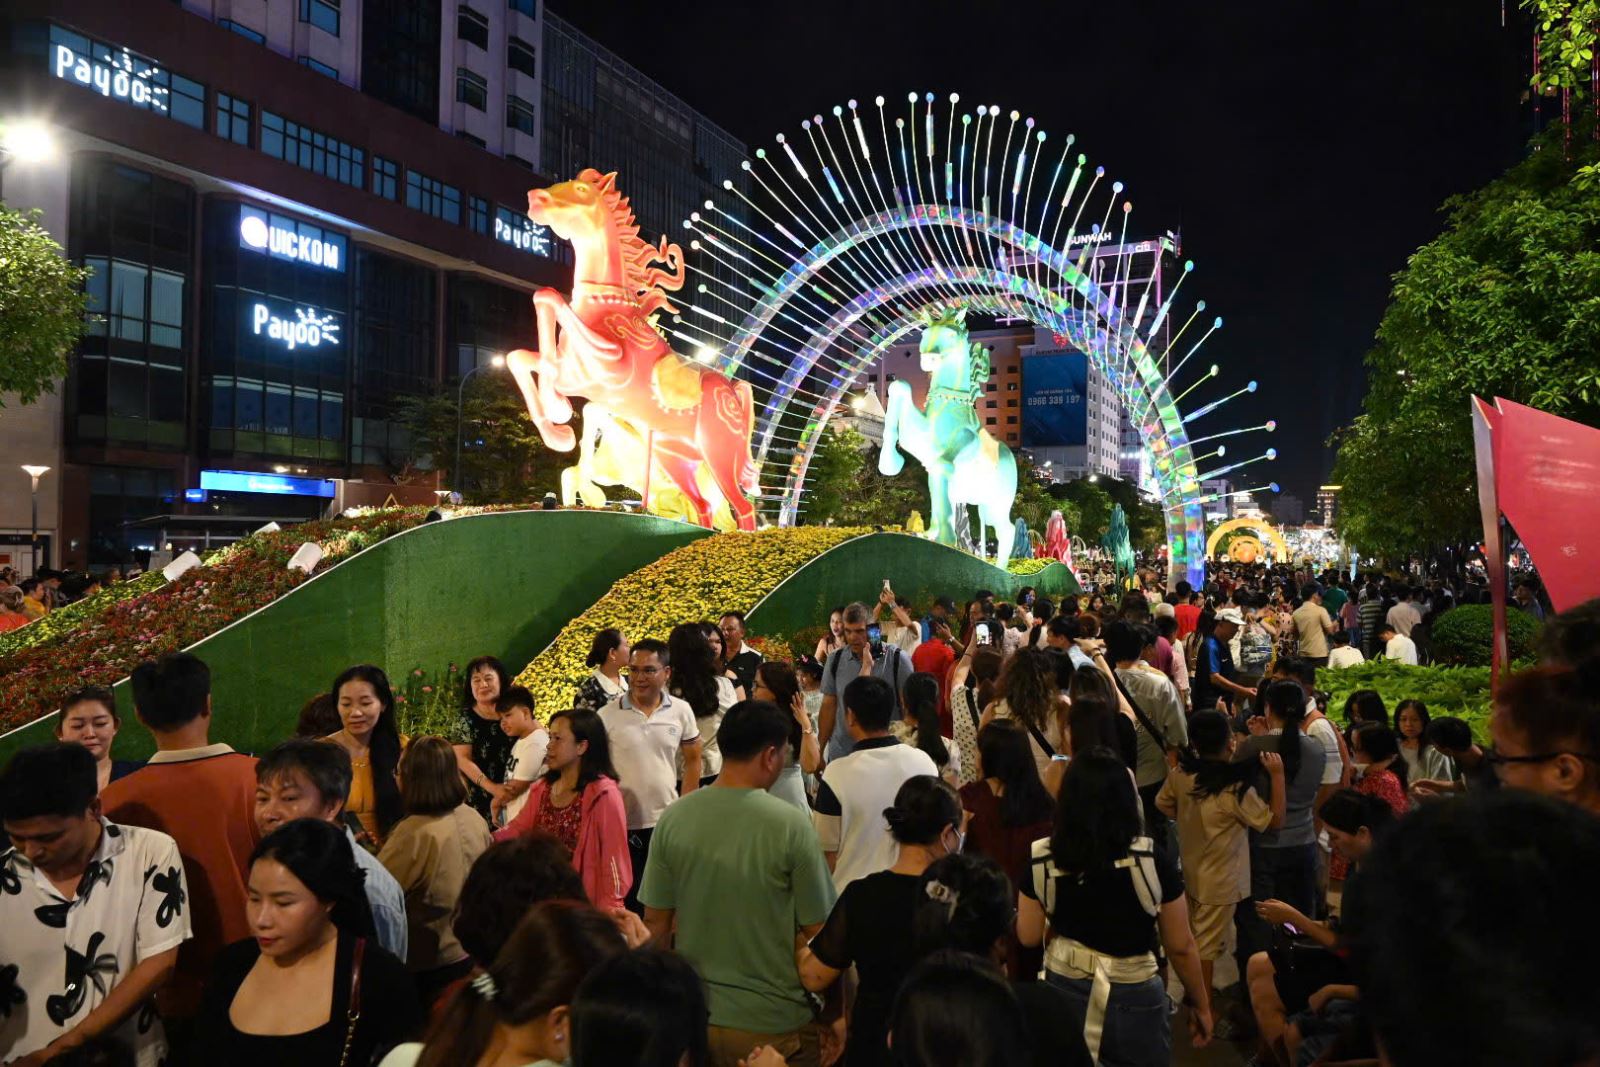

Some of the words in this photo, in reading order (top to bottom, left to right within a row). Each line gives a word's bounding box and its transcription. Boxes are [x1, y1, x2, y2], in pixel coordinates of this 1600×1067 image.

[57, 45, 145, 103] Payoo
[496, 218, 539, 251] Payoo
[254, 304, 320, 349] Payoo
